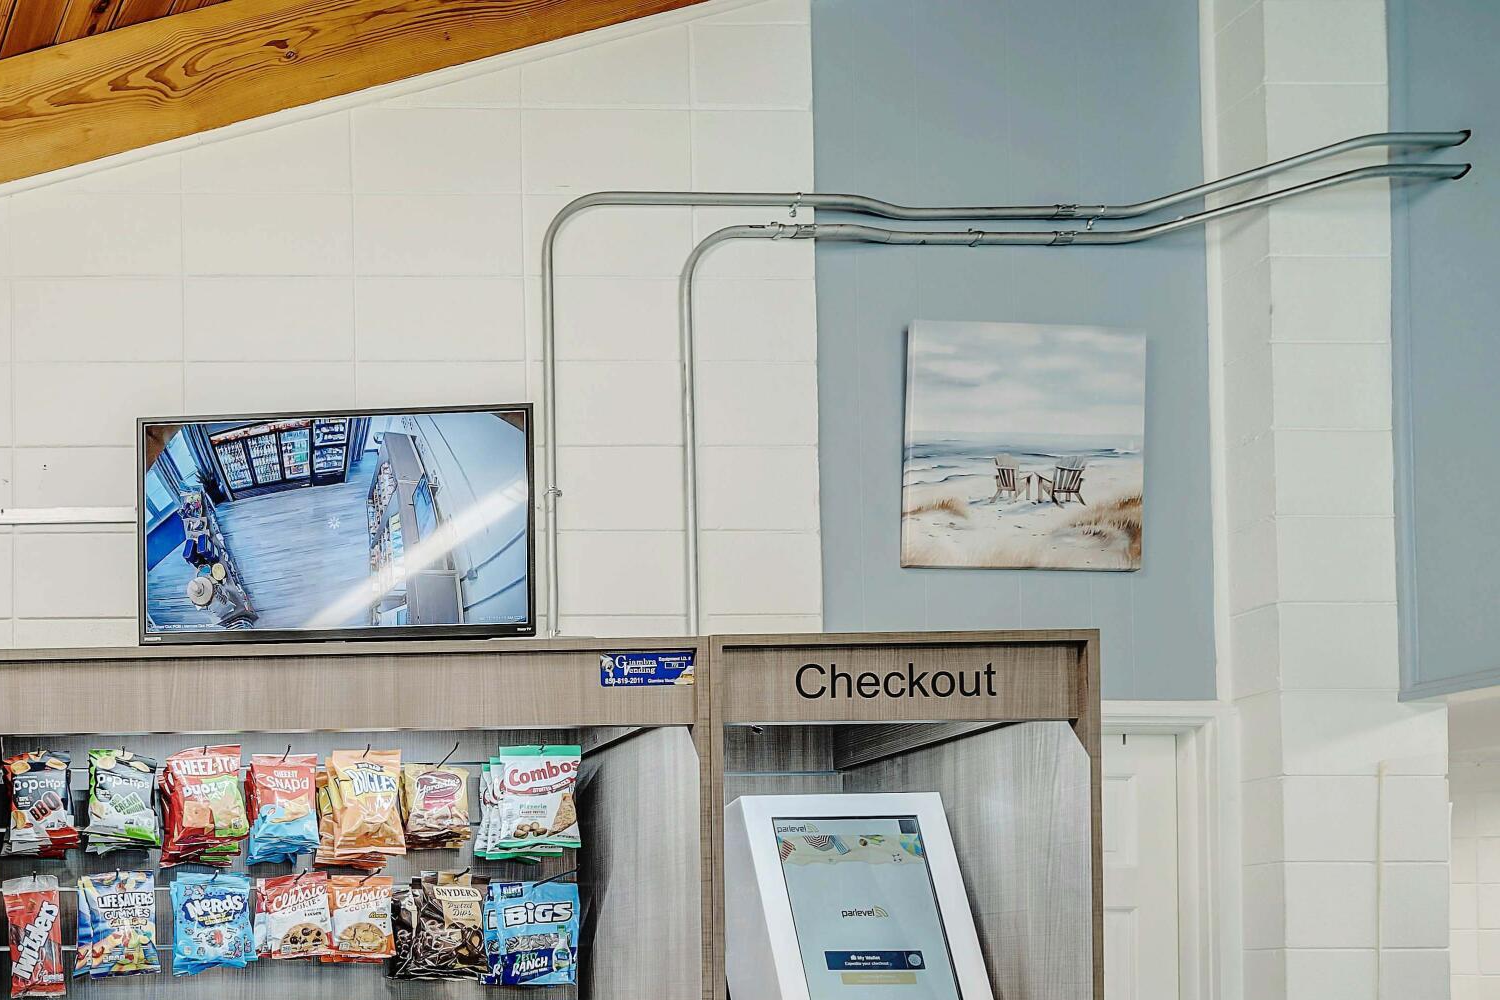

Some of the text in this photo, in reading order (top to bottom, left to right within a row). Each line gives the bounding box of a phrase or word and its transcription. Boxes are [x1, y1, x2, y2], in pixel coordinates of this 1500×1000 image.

[615, 655, 657, 668] Giambra
[623, 666, 656, 676] Vending
[796, 662, 997, 699] Checkout
[508, 758, 580, 785] Combos
[97, 773, 150, 790] popchips
[350, 769, 397, 797] BUGLES
[337, 887, 390, 907] Classic
[435, 887, 479, 898] SNYDER'S
[103, 908, 150, 920] GUMMIES
[841, 907, 875, 919] parlevel
[12, 900, 60, 980] Twizzlers
[511, 956, 548, 977] RANCH
